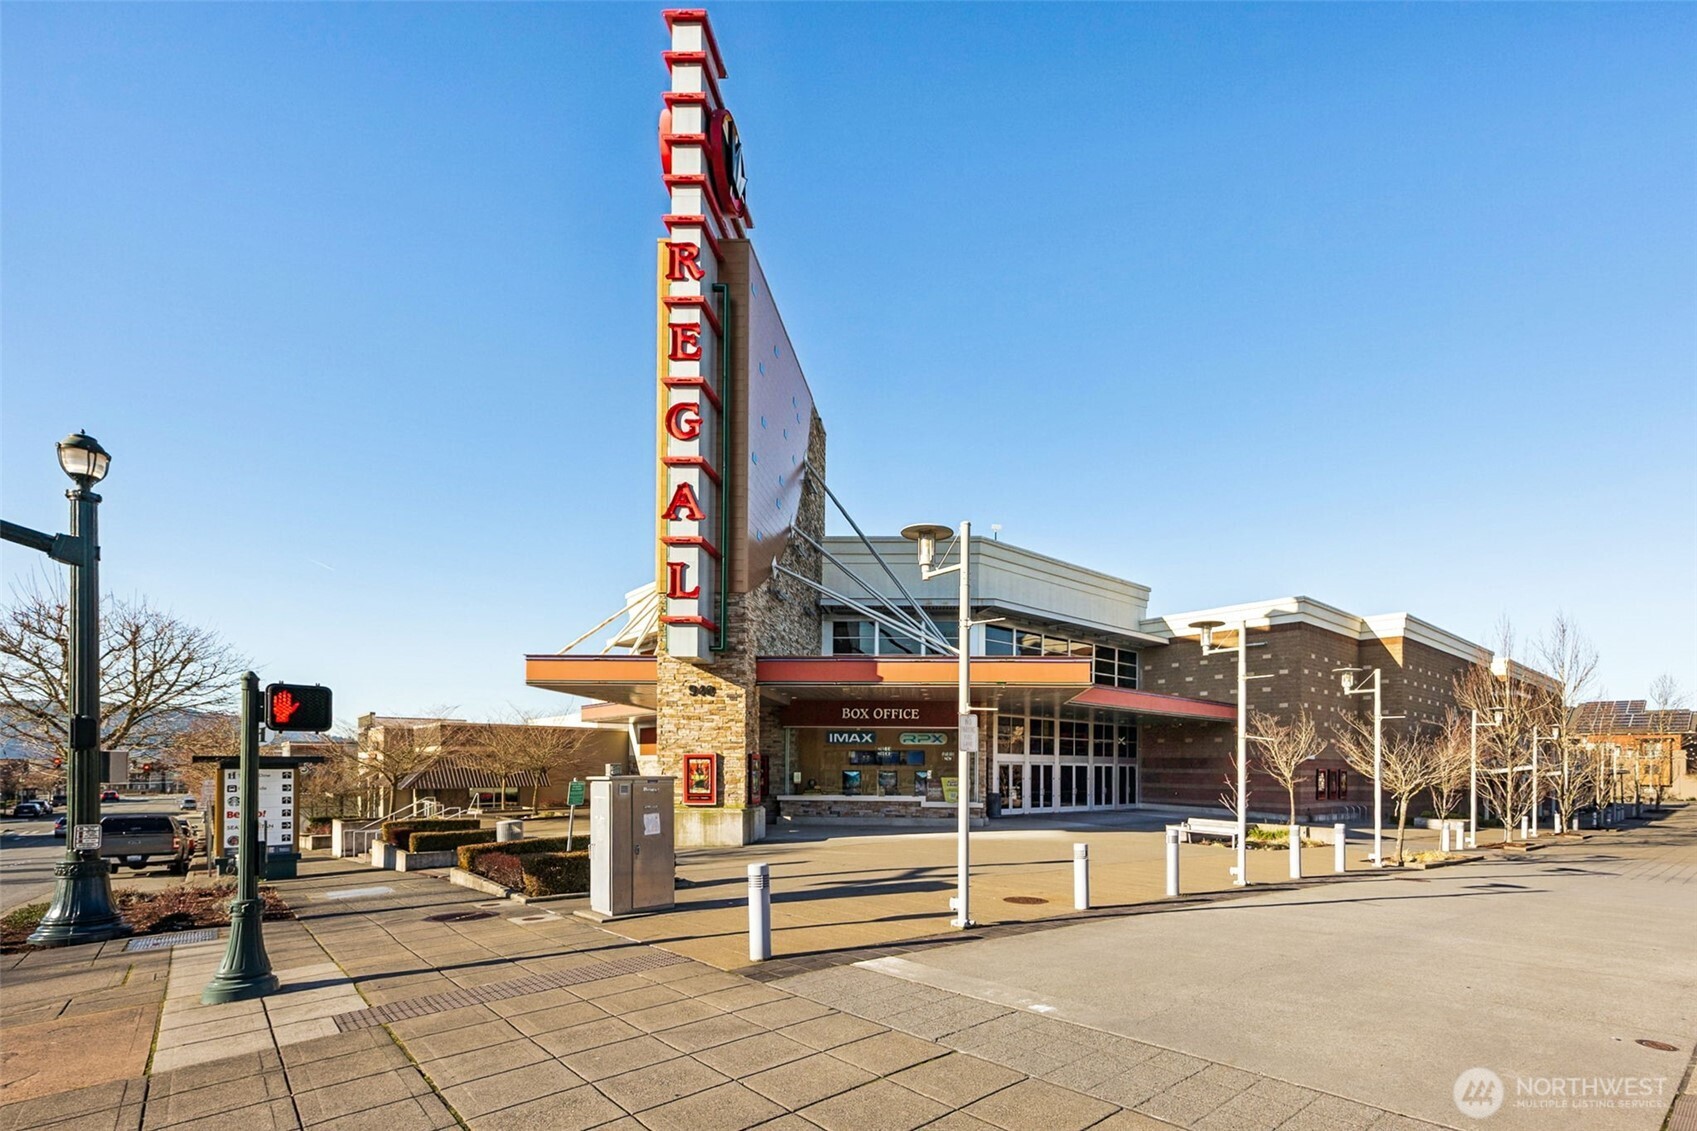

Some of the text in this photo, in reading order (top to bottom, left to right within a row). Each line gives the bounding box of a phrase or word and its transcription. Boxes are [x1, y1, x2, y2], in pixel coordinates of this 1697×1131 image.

[661, 242, 706, 599] REGAL
[842, 708, 920, 719] BOX OFFICE
[829, 733, 873, 743] IMAX
[903, 734, 943, 743] RPX
